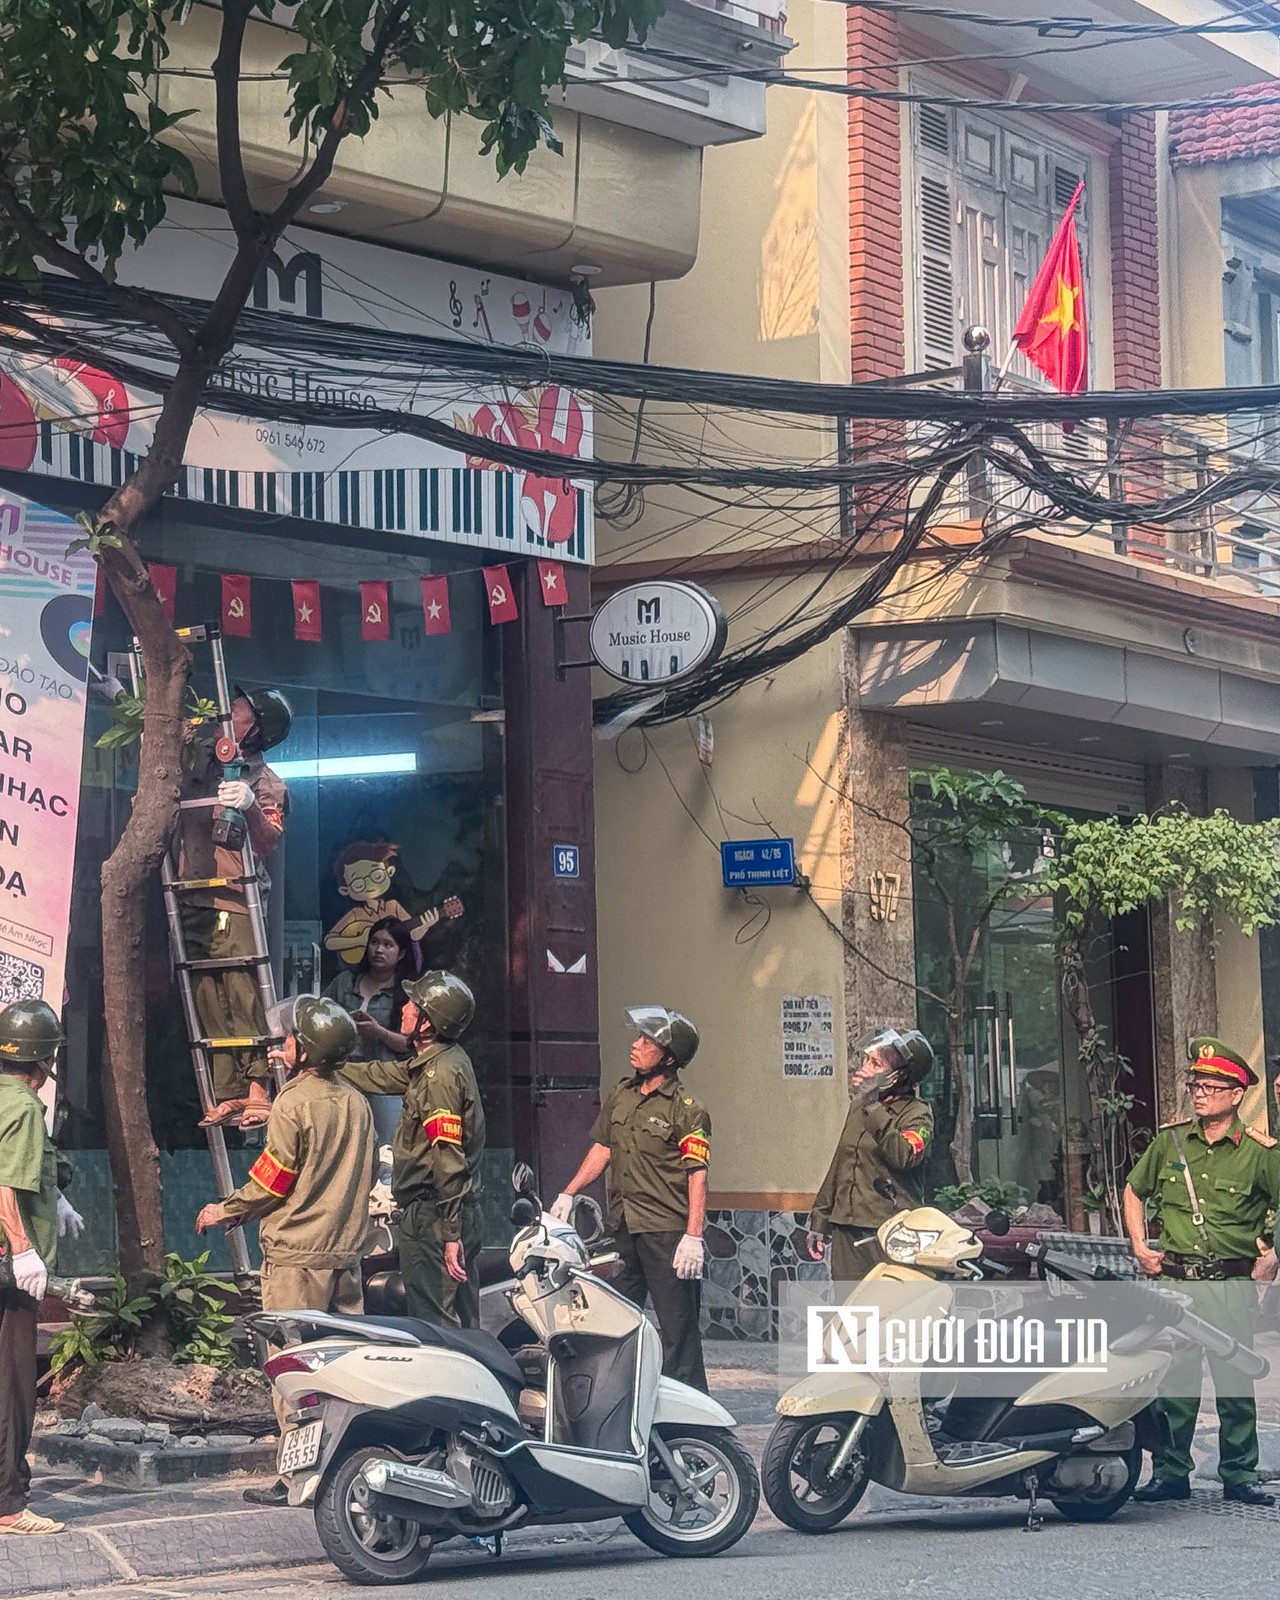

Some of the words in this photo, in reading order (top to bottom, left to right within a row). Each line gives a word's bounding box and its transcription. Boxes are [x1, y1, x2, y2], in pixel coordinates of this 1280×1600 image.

[206, 361, 278, 402] usic
[255, 428, 281, 447] 0961
[307, 438, 326, 454] 672
[608, 631, 647, 647] Music
[649, 629, 691, 644] House
[40, 674, 73, 700] TẠO
[559, 851, 574, 872] 95
[288, 1425, 316, 1450] 29-H1
[282, 1444, 316, 1471] 555.55
